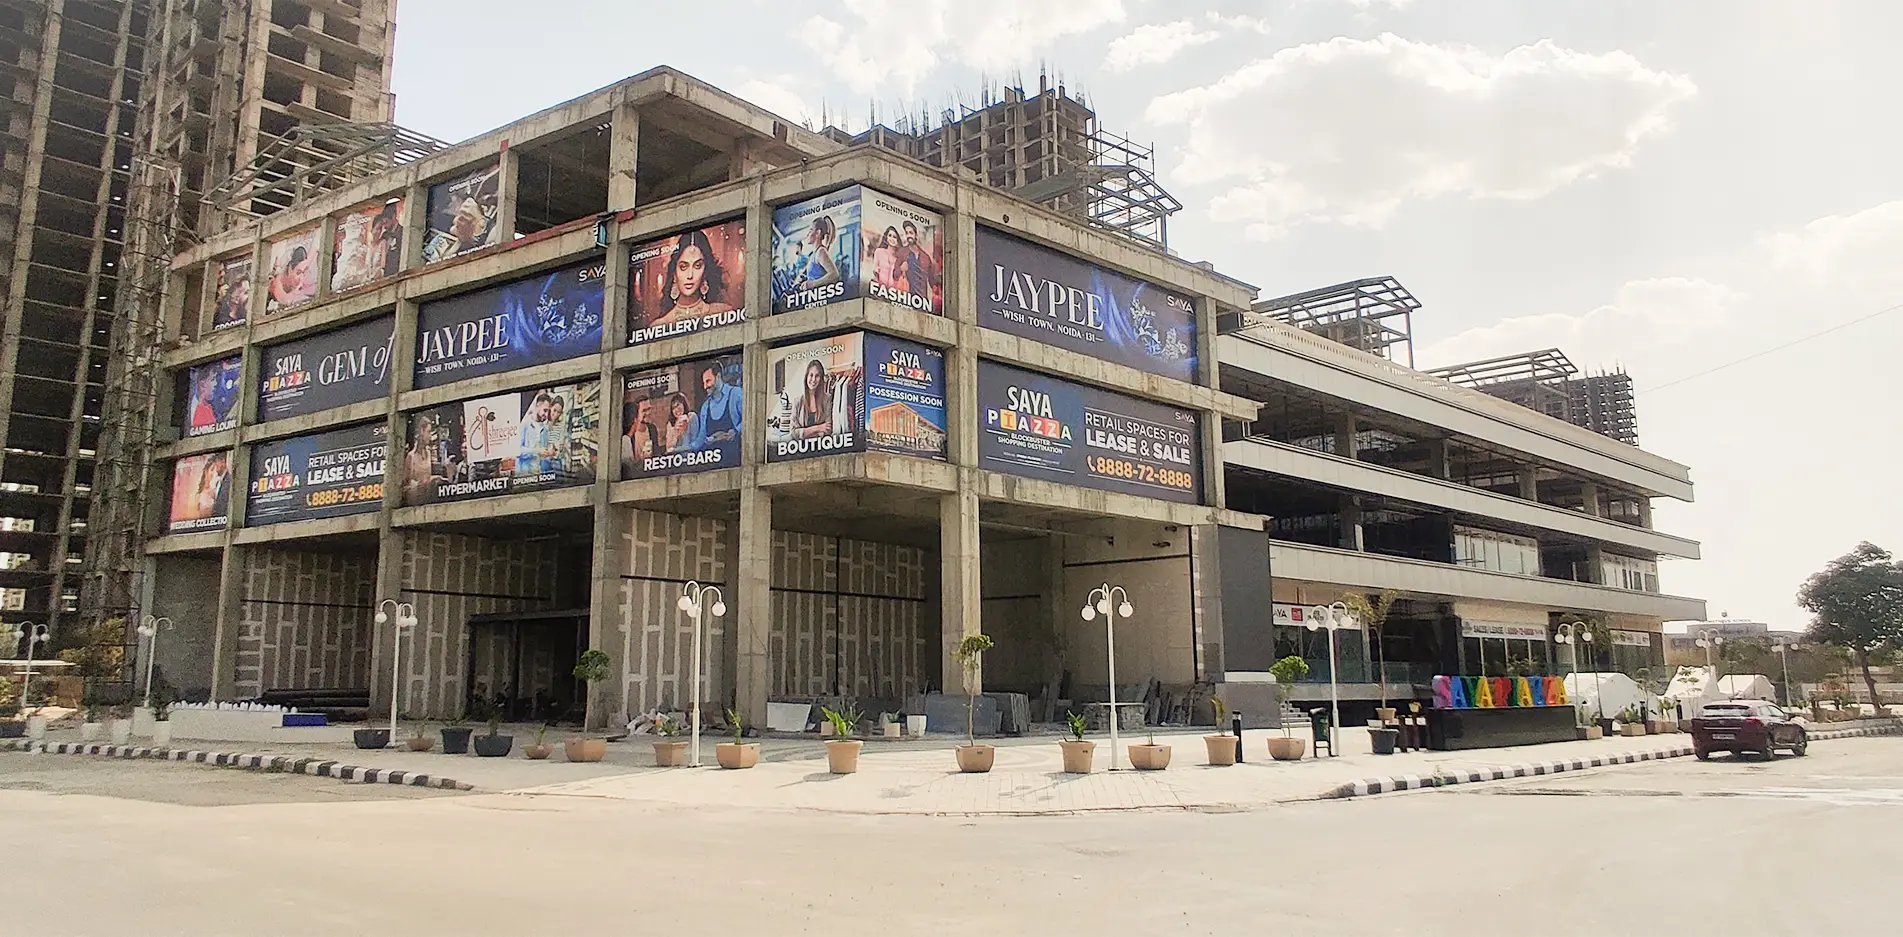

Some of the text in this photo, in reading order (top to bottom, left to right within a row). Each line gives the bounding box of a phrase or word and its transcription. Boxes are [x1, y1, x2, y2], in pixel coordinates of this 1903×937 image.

[822, 199, 843, 211] SOON
[875, 200, 930, 225] OPENING SOON
[631, 243, 680, 261] OPENING SOON
[786, 281, 845, 309] FITNESS
[804, 301, 828, 310] CENTER
[869, 280, 933, 312] FASHION
[990, 264, 1105, 330] JAYPEE
[1167, 295, 1194, 314] SAYA
[1002, 309, 1025, 324] WISH
[417, 313, 510, 364] JAYPEE
[628, 318, 702, 344] JEWELLERY
[318, 328, 395, 386] GEM of
[822, 344, 845, 356] SOON
[891, 350, 921, 369] SAYA
[275, 353, 302, 376] SAYA
[425, 364, 442, 374] WISH
[879, 363, 933, 382] PIAZZA
[262, 371, 312, 393] PIAZZA
[627, 373, 677, 389] OPENING SOON
[869, 386, 943, 407] POSSESSION SOON
[1007, 386, 1053, 419] SAYA
[986, 407, 1072, 441] PIAZZA
[1084, 411, 1190, 446] RETAIL SPACES FOR
[1174, 411, 1196, 424] SAYA
[190, 423, 215, 437] GAMING
[1011, 433, 1051, 446] BLOCKBUSTER
[777, 432, 854, 456] BOUTIQUE
[997, 436, 1063, 454] SHOPPING DESTINATION
[1086, 428, 1191, 465] LEASE & SALE
[263, 455, 290, 477] SAYA
[308, 456, 336, 468] RETAIL
[338, 448, 370, 463] SPACES
[643, 449, 722, 472] RESTO-BARS
[251, 473, 300, 493] PIAZZA
[307, 460, 386, 485] LEASE & SALE
[1096, 456, 1193, 489] 8888-72-8888
[438, 473, 556, 497] HYPERMARKET OPENING SOON
[1432, 675, 1495, 709] SAYA
